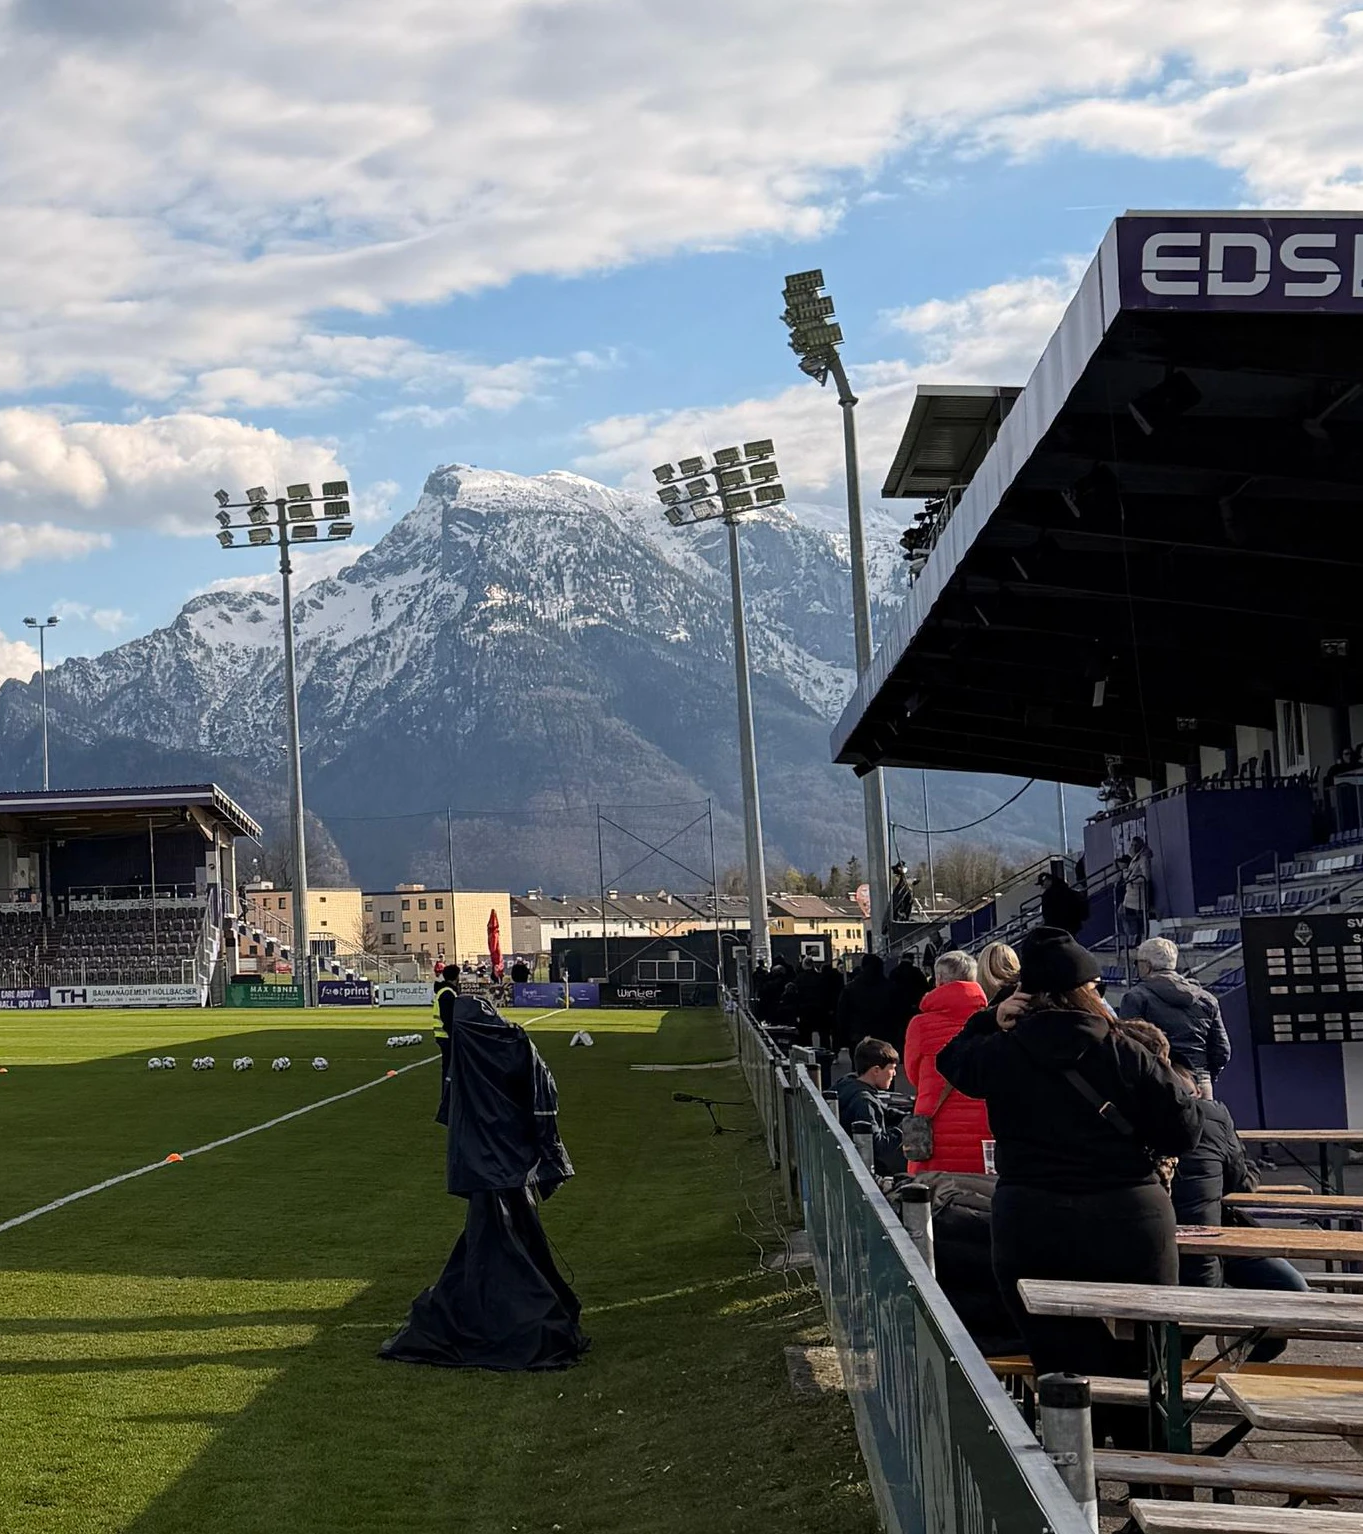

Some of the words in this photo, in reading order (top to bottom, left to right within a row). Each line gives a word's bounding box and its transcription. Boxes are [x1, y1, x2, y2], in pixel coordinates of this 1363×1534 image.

[1142, 232, 1363, 297] EDS
[1, 990, 15, 999] CARE
[16, 989, 35, 999] ABOUT
[250, 985, 268, 993] MAX
[321, 984, 369, 998] footprint
[396, 987, 428, 995] PROJECT
[55, 988, 87, 1004] TH
[18, 999, 29, 1008] DO
[30, 999, 49, 1008] YOU?
